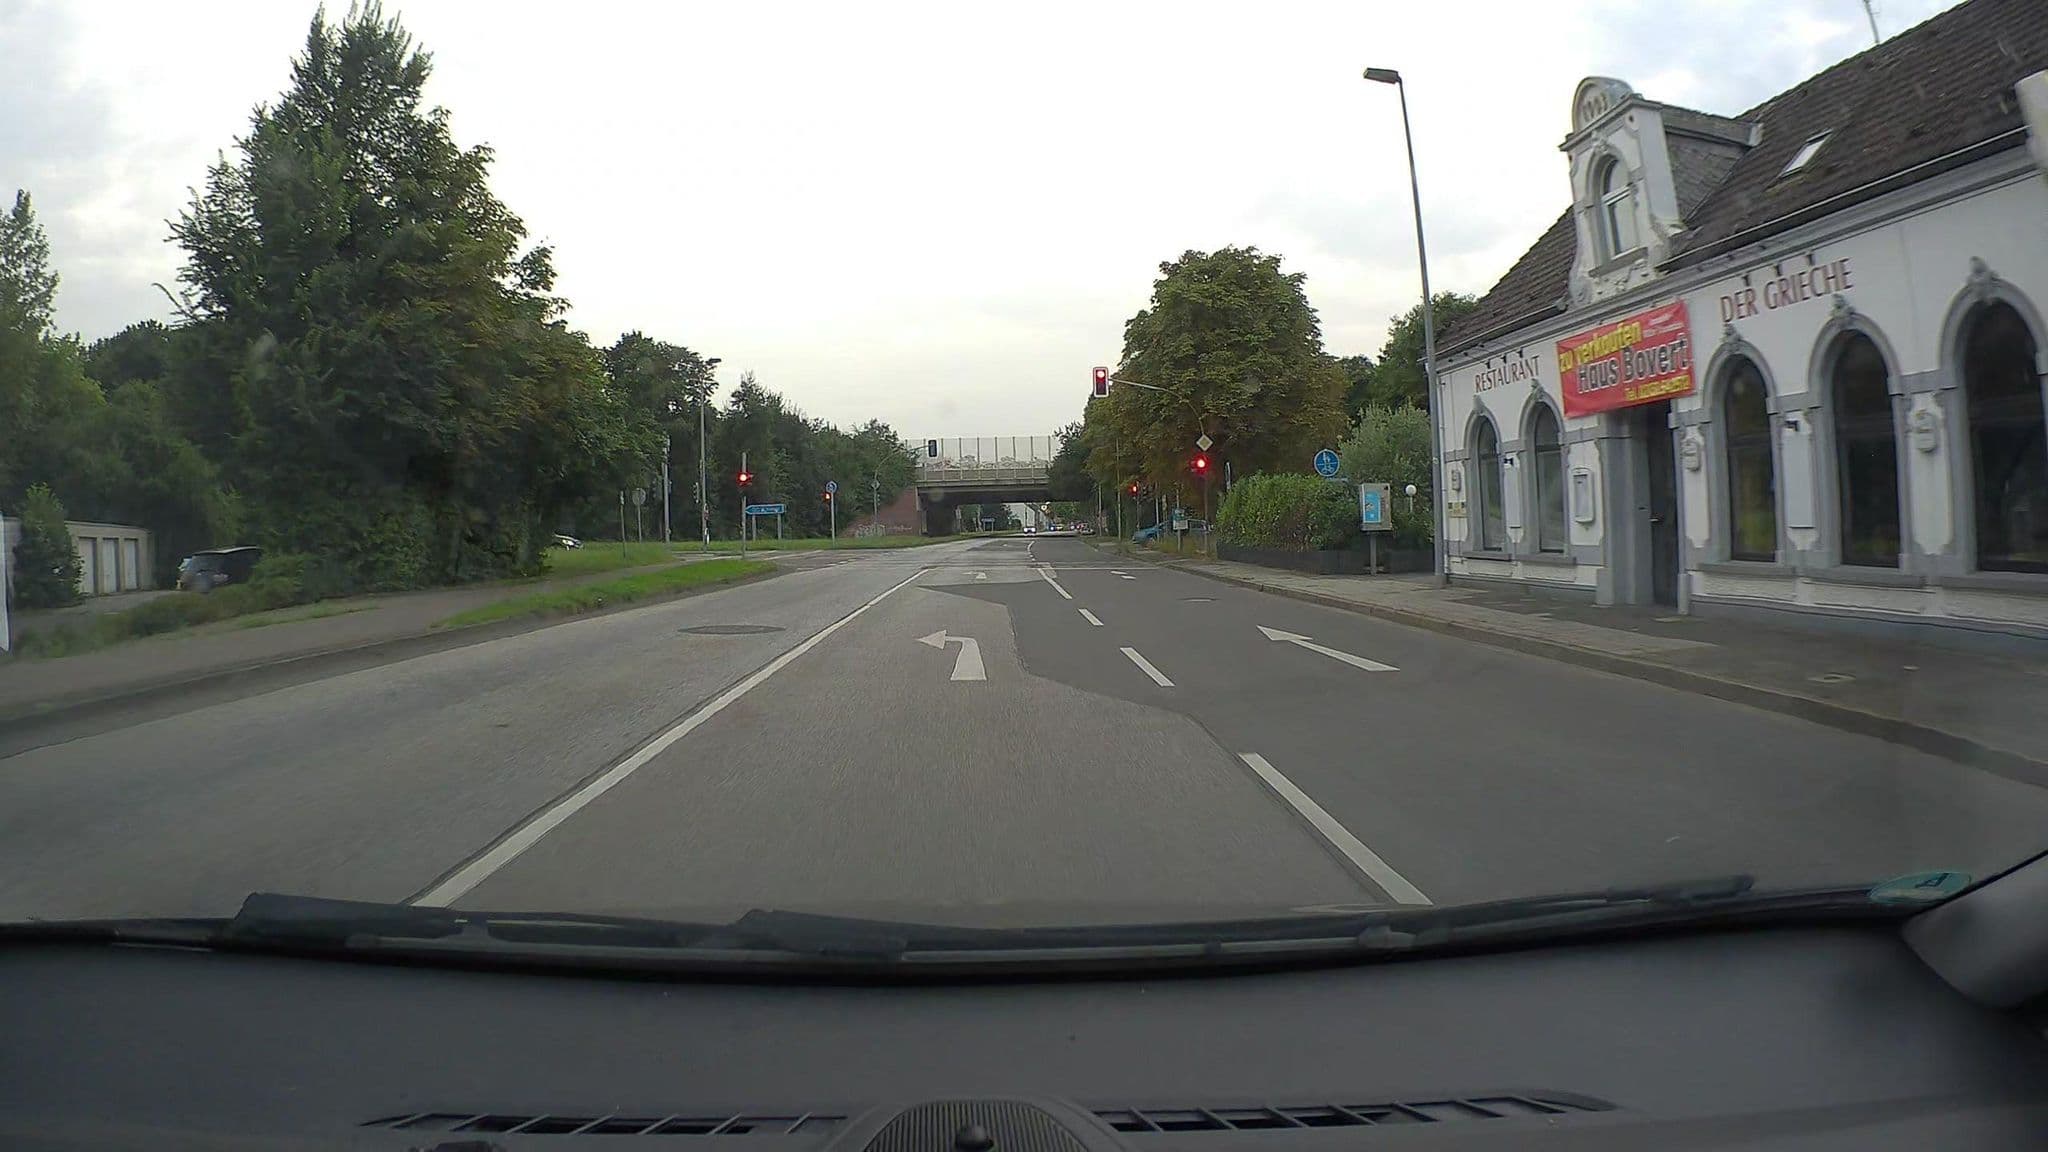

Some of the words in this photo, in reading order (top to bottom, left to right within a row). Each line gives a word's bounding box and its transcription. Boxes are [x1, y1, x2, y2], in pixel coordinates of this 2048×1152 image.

[1720, 288, 1758, 323] DER
[1764, 257, 1854, 310] GRIECHE
[1475, 355, 1539, 393] RESTAURANT
[1577, 357, 1622, 394] Haus
[1622, 332, 1689, 383] Bovert
